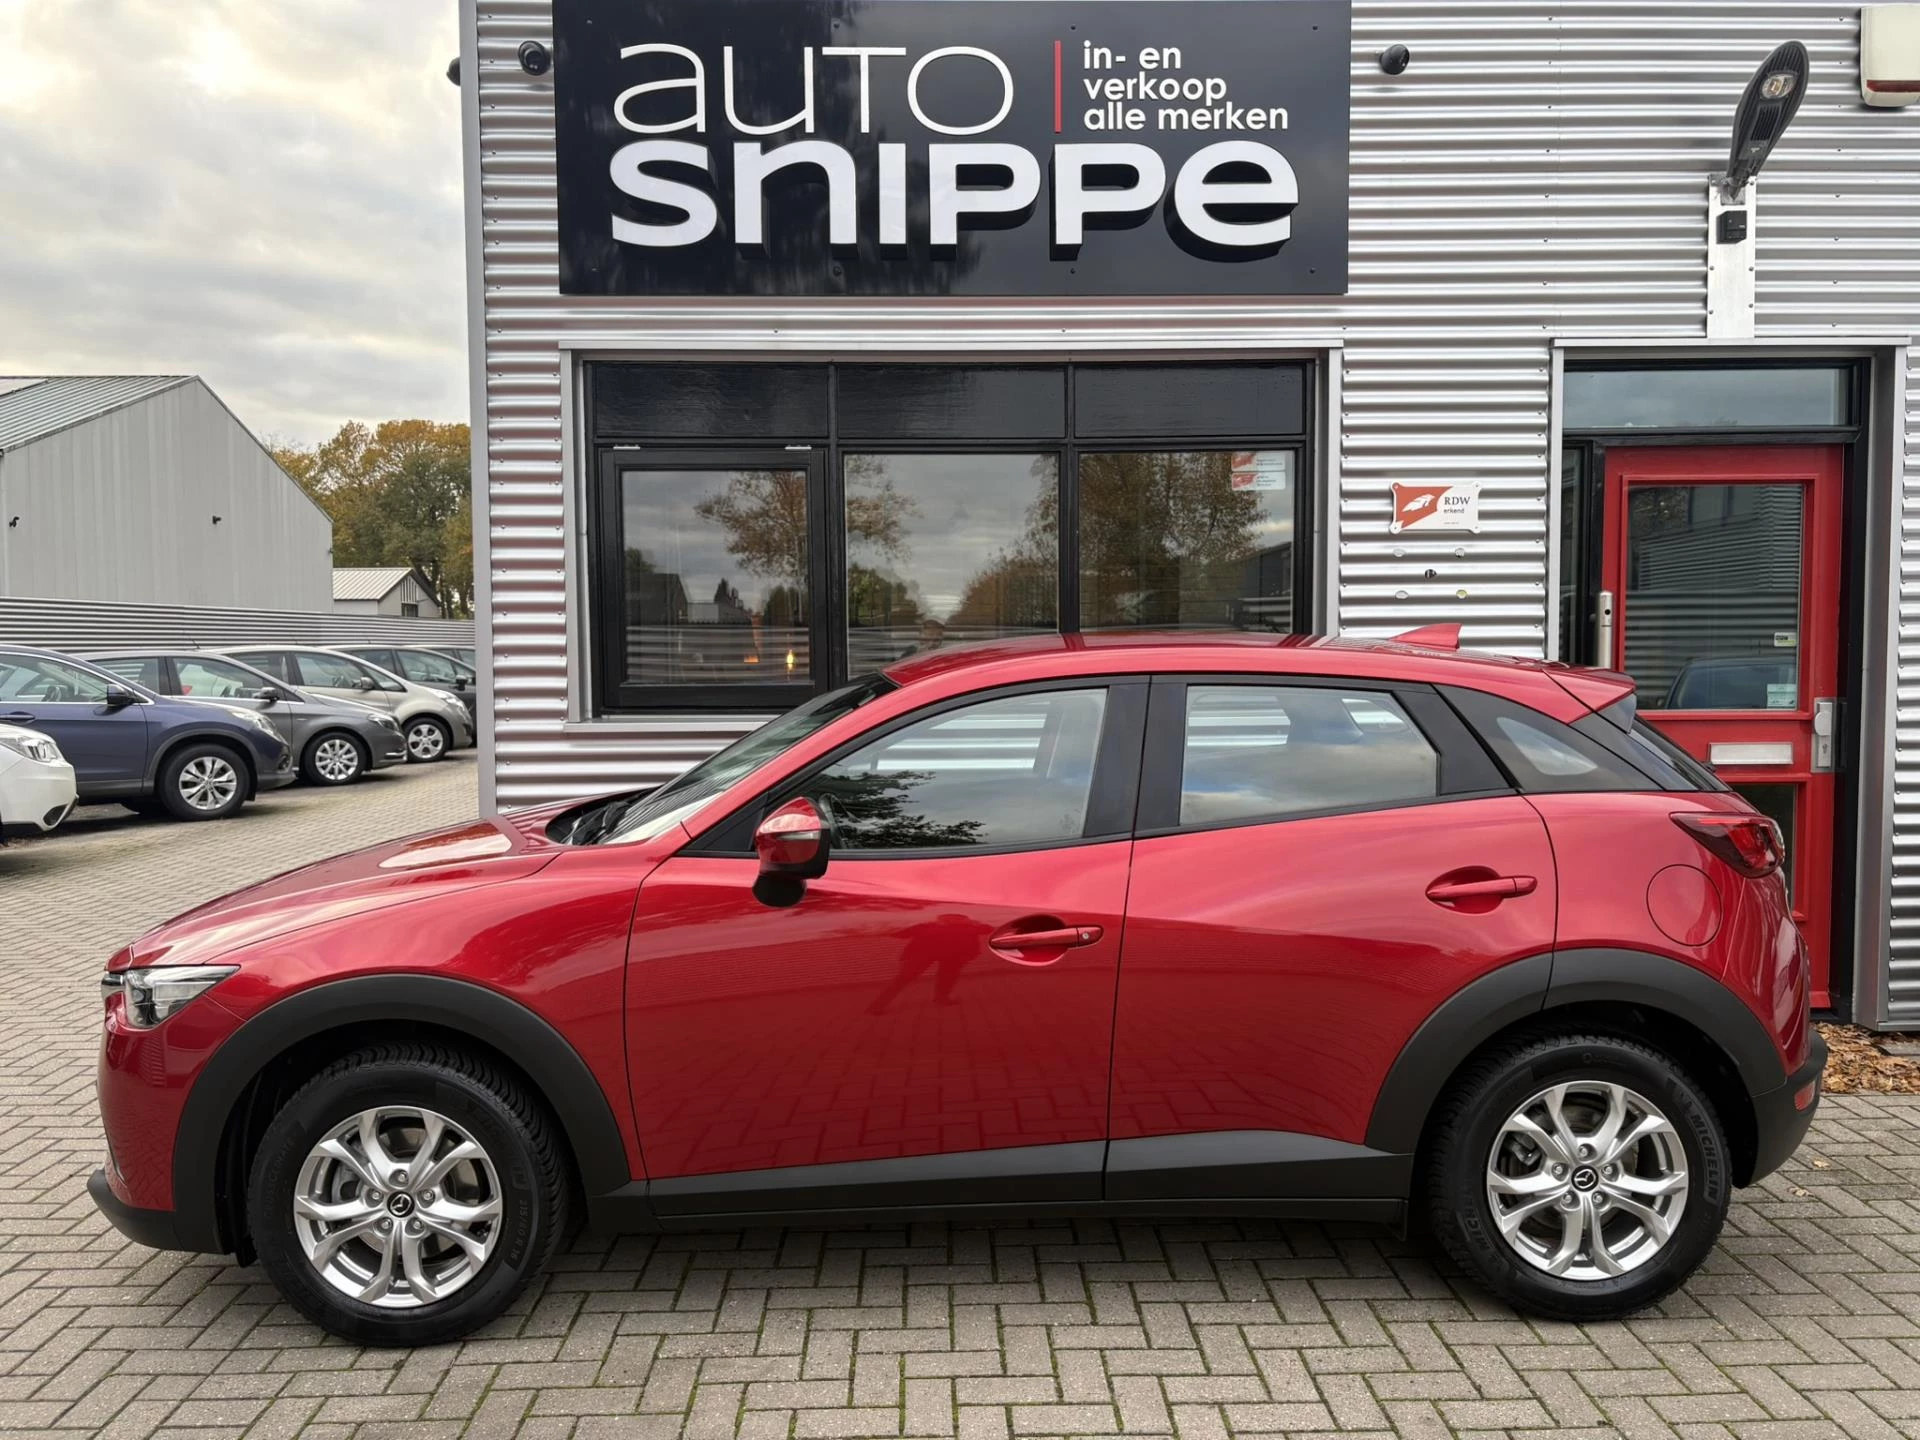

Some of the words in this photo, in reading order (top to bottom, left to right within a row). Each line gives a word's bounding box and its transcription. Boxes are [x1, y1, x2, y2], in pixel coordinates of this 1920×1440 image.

[1083, 40, 1126, 69] in-
[1139, 47, 1181, 69] en
[1083, 71, 1227, 106] verkoop
[1084, 101, 1146, 130] alle
[1158, 101, 1288, 130] merken
[1443, 496, 1471, 506] RDW
[1690, 1113, 1719, 1201] MICHELIN
